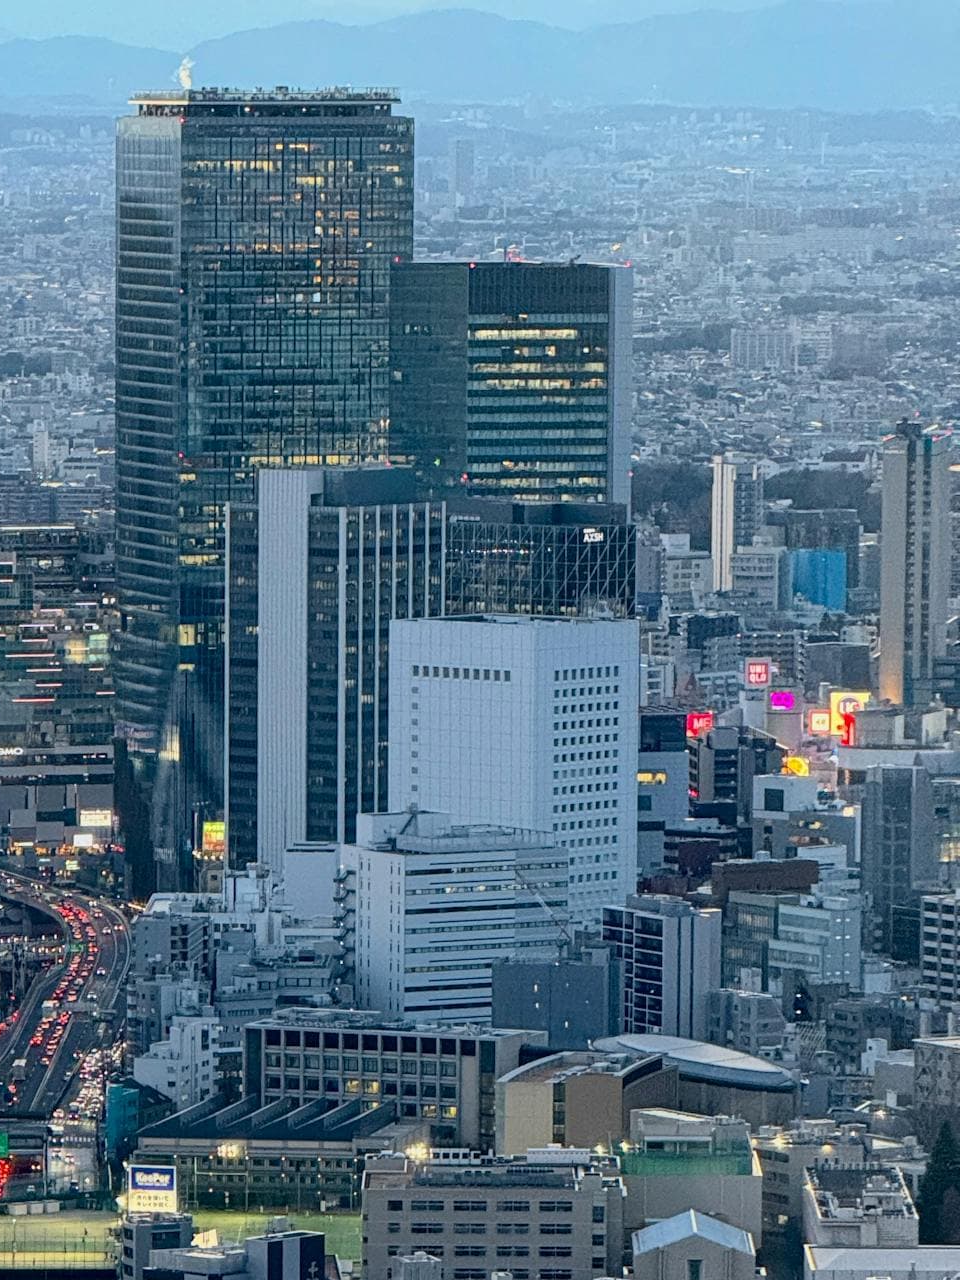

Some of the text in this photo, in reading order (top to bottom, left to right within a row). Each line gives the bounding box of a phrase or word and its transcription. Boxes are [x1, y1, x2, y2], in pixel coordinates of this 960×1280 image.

[750, 664, 766, 673] UNI
[750, 673, 767, 682] QLO
[135, 1171, 171, 1185] KeePer
